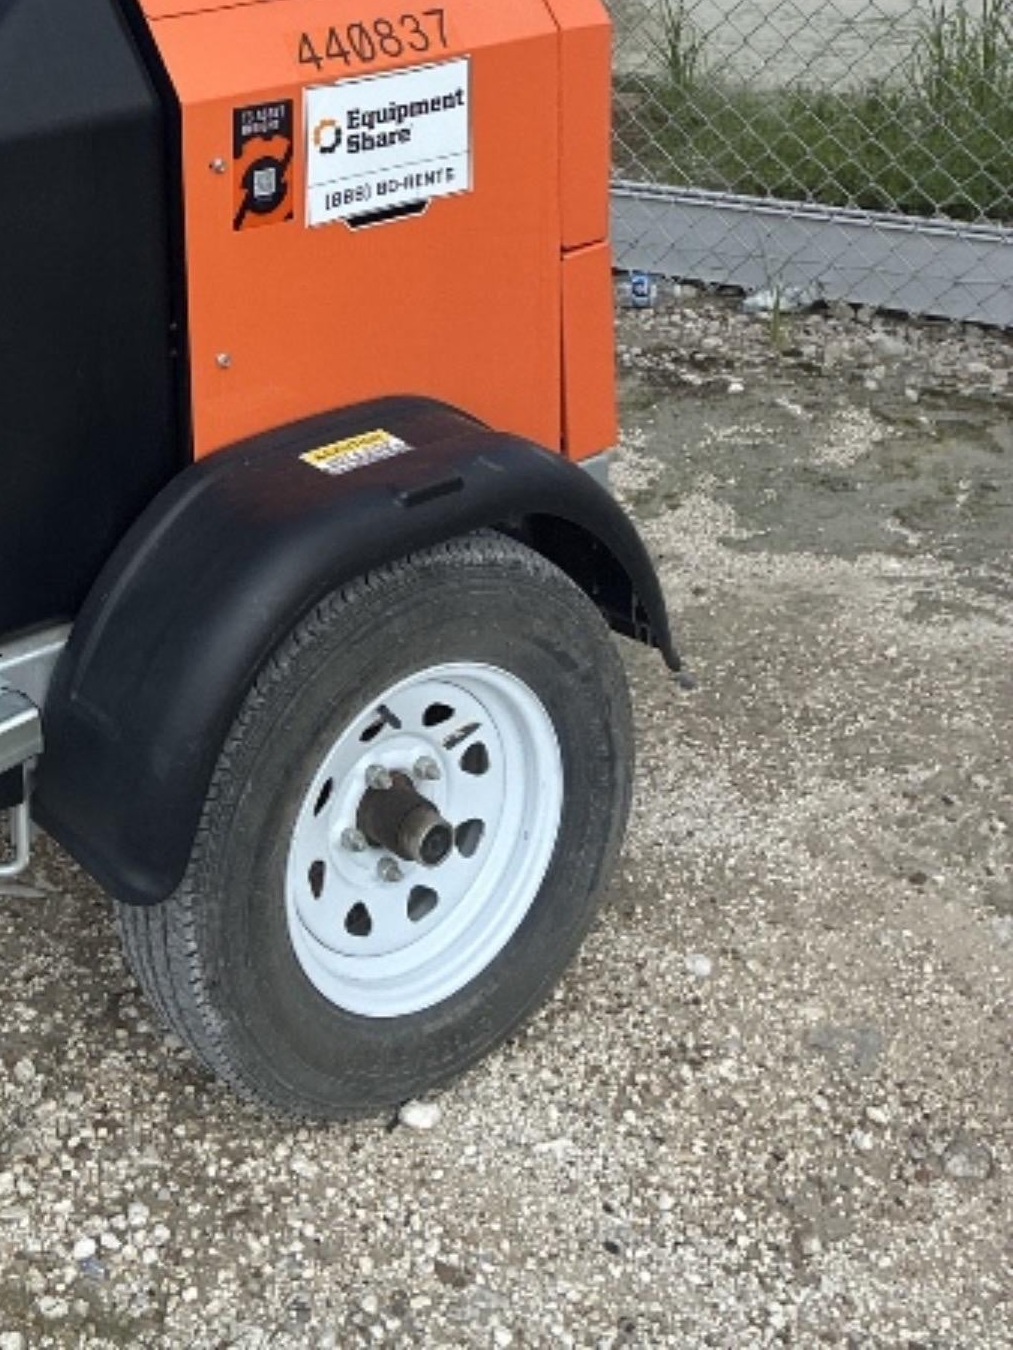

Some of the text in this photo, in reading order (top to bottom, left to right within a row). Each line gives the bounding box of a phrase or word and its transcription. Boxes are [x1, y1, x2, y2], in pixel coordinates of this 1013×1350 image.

[298, 9, 448, 70] 440837
[346, 88, 465, 129] Equipment
[346, 128, 411, 154] Share
